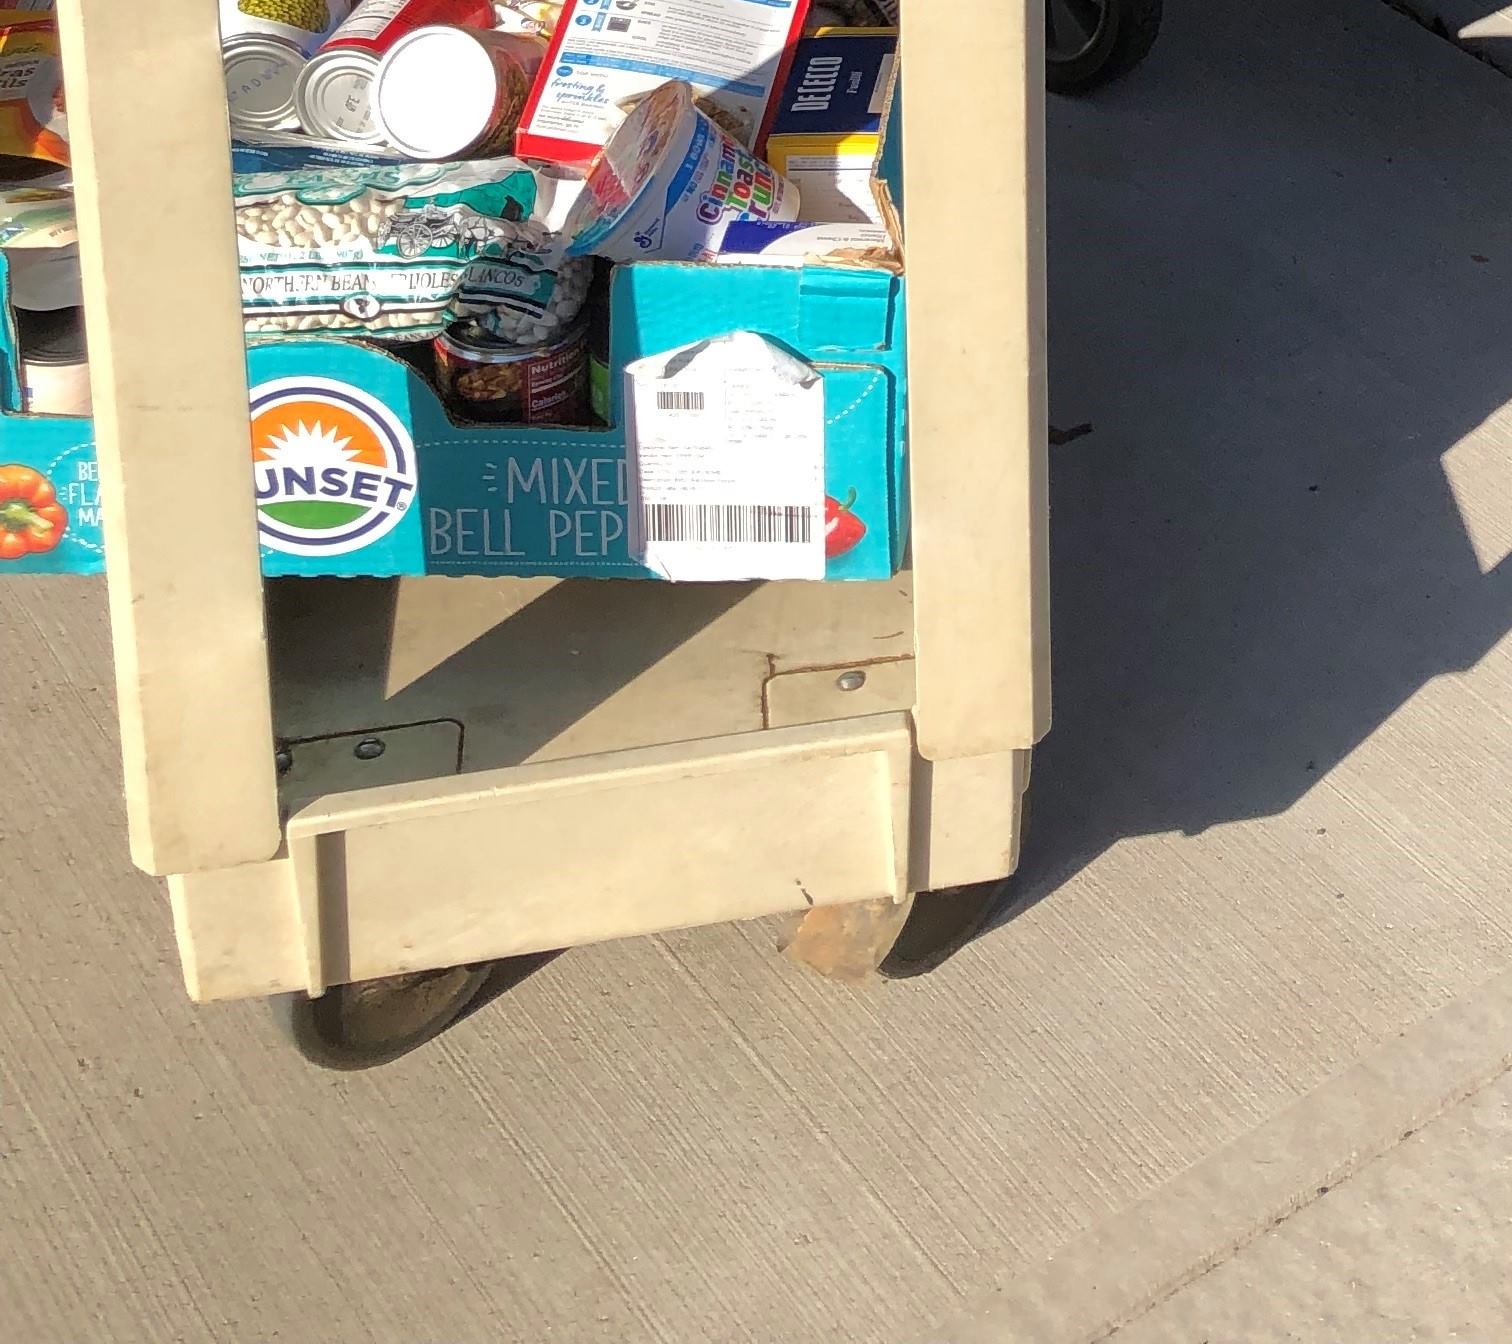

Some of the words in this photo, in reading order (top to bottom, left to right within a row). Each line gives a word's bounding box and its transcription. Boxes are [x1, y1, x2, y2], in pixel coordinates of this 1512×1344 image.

[255, 464, 413, 510] UNSET
[430, 508, 524, 557] BELL
[549, 508, 624, 557] PEP
